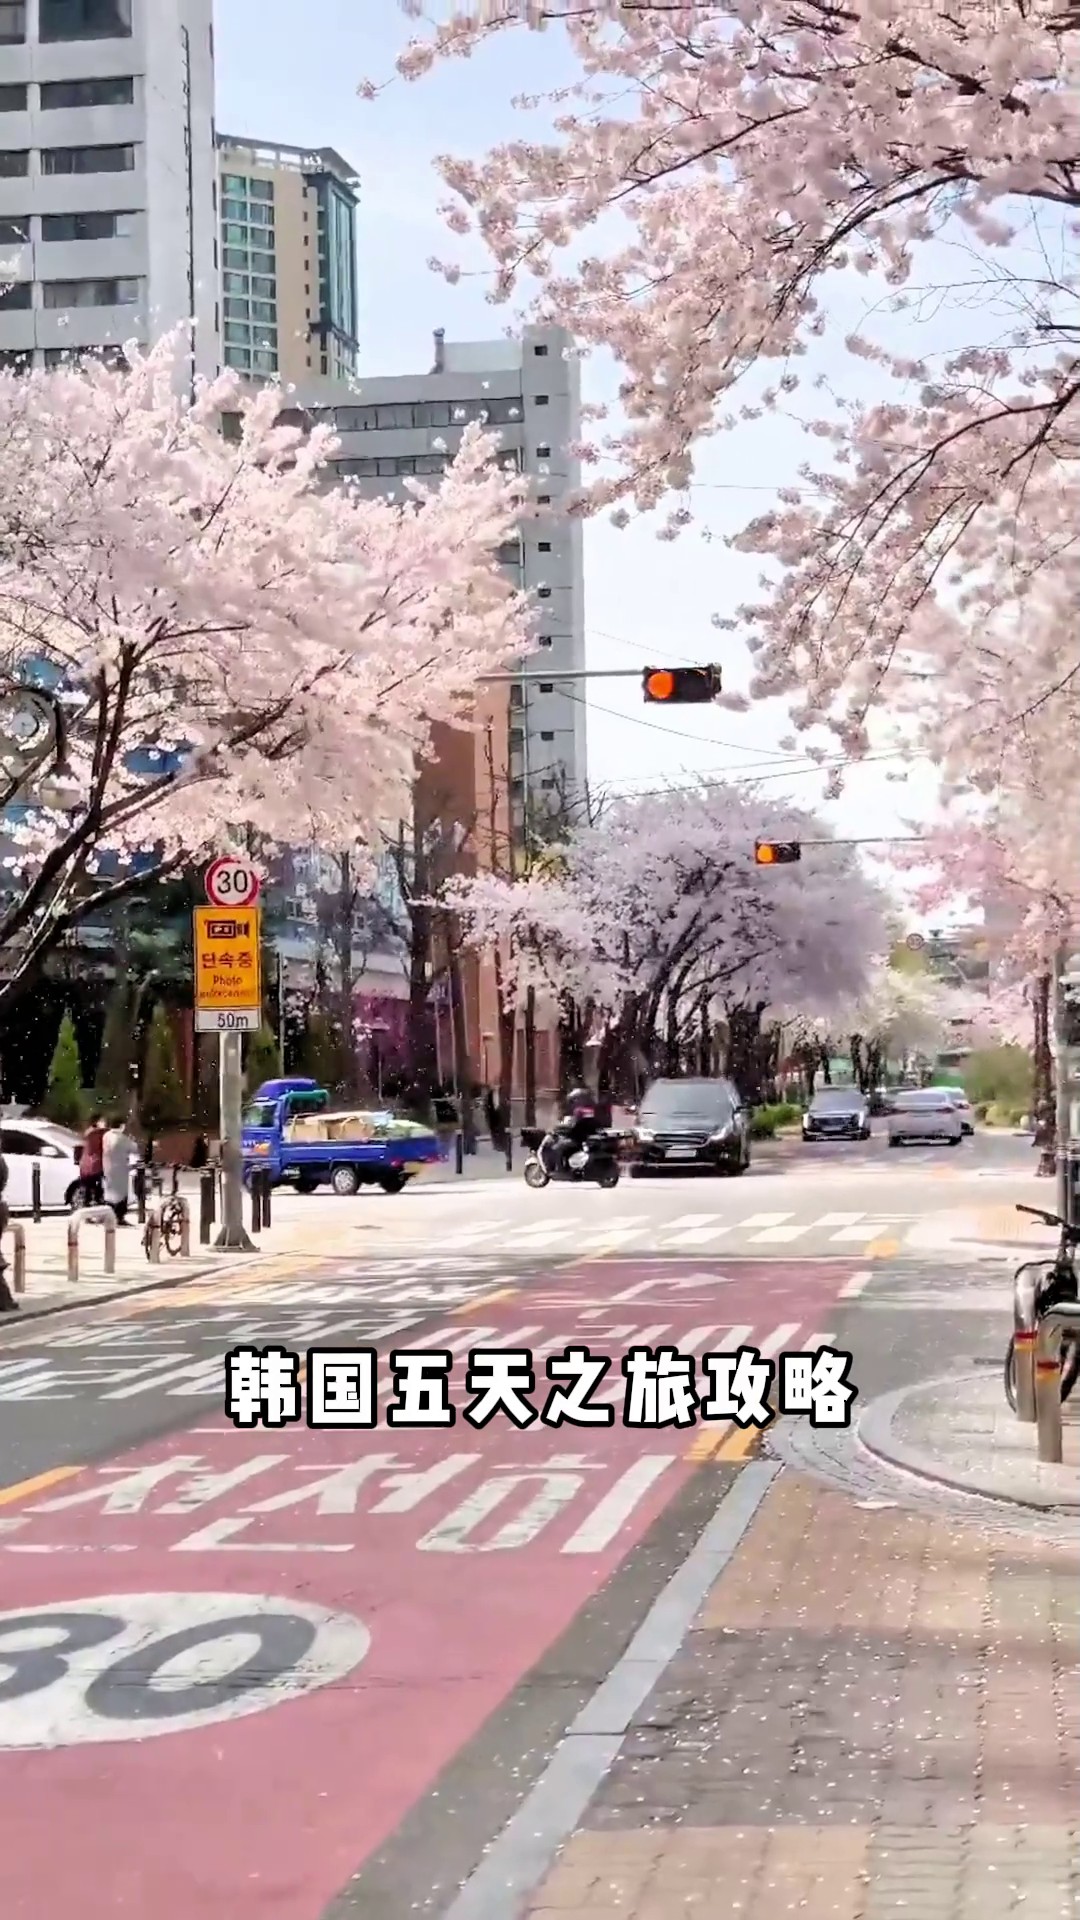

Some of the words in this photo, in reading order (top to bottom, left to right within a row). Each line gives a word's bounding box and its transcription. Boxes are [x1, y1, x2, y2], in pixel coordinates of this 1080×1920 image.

[217, 870, 248, 894] 30
[202, 952, 253, 970] 단속중
[213, 974, 243, 985] Photo
[217, 1013, 249, 1028] 50m
[0, 1453, 676, 1554] 천천히
